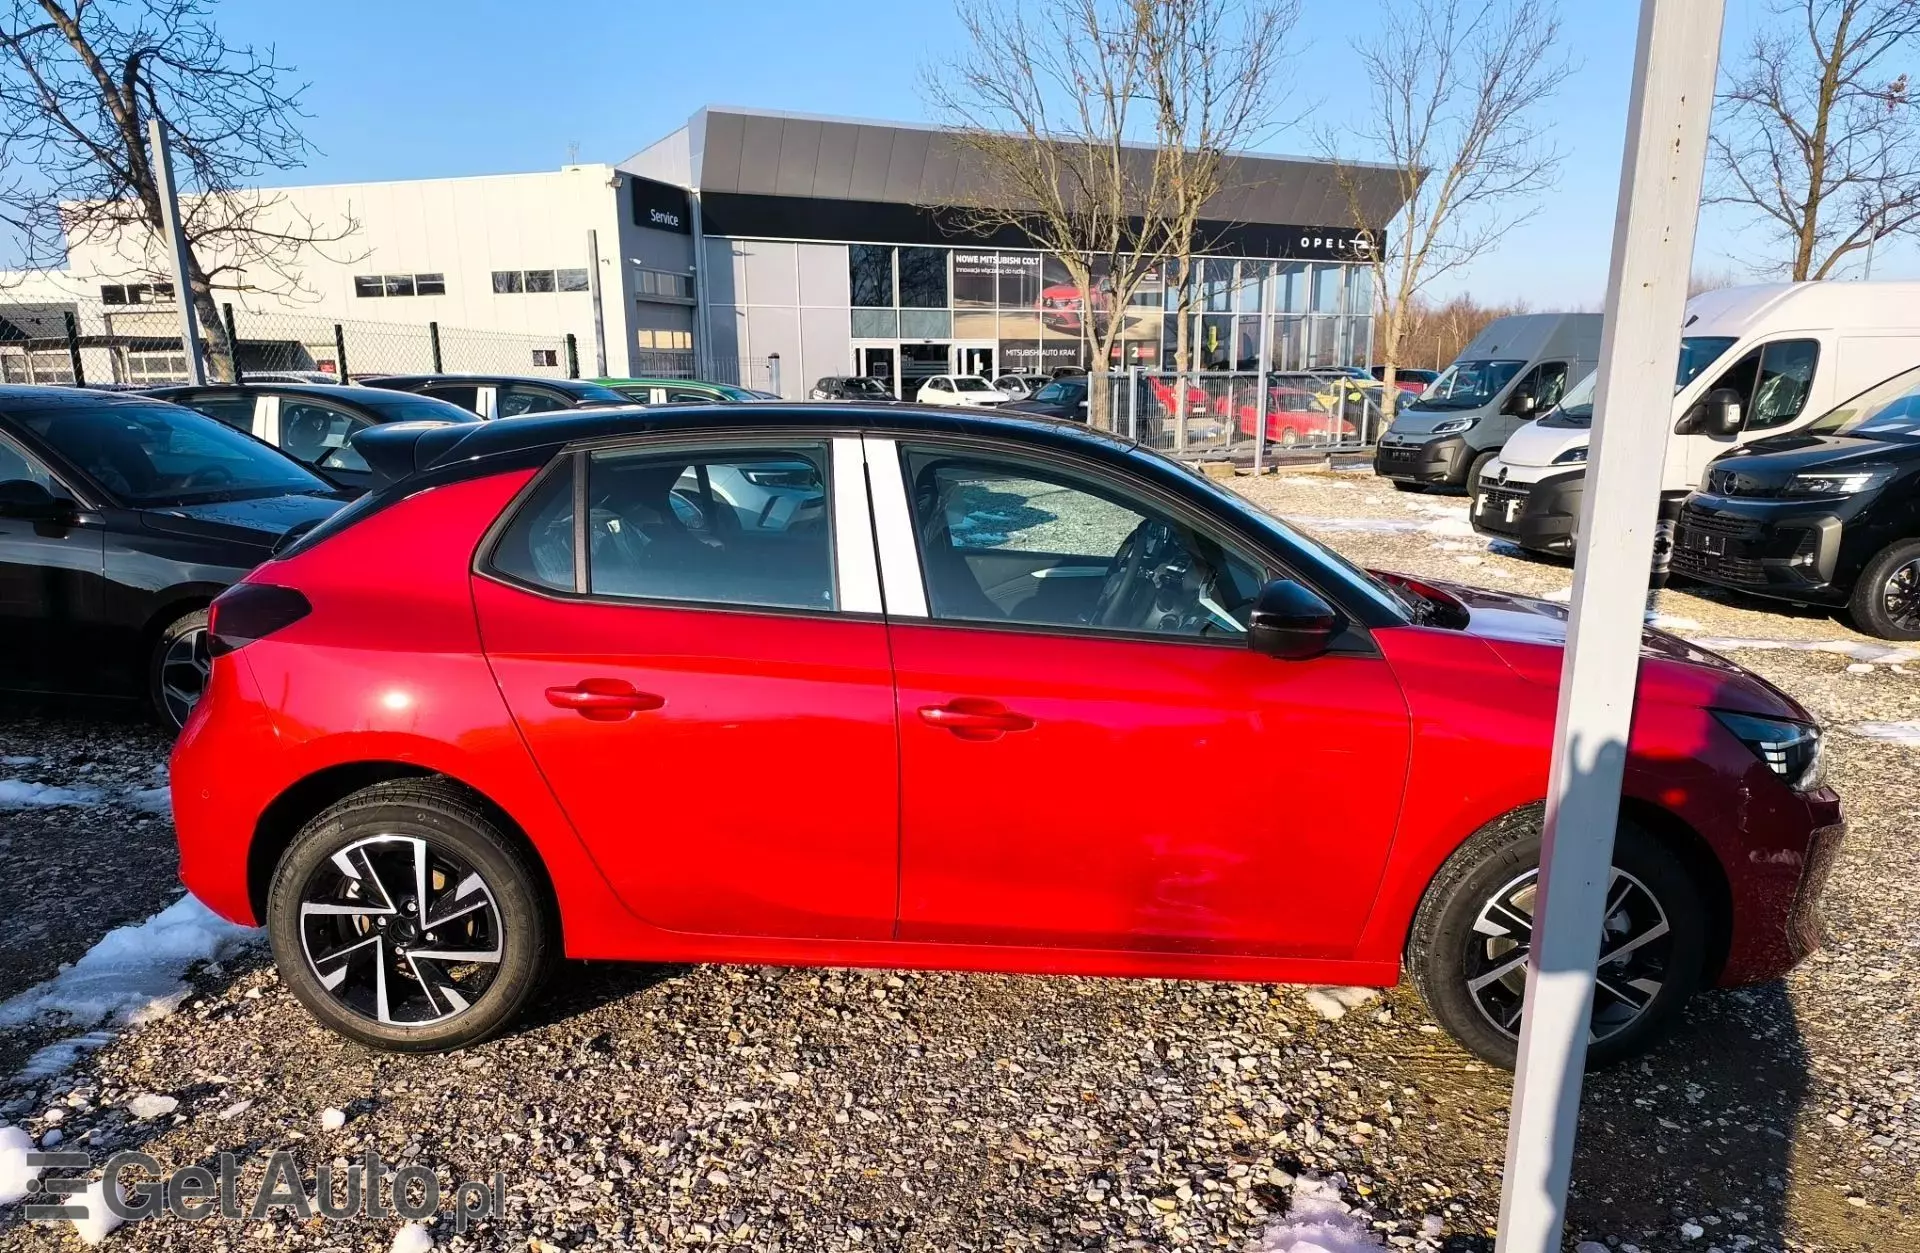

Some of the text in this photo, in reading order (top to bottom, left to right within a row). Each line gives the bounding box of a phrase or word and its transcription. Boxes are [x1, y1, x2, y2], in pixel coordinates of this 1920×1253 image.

[650, 208, 679, 227] Service
[1300, 237, 1346, 249] OPEL
[955, 254, 1040, 265] NOWE MITSUBISHI COLT
[1042, 349, 1058, 357] AUTO
[1059, 349, 1076, 357] KRAK
